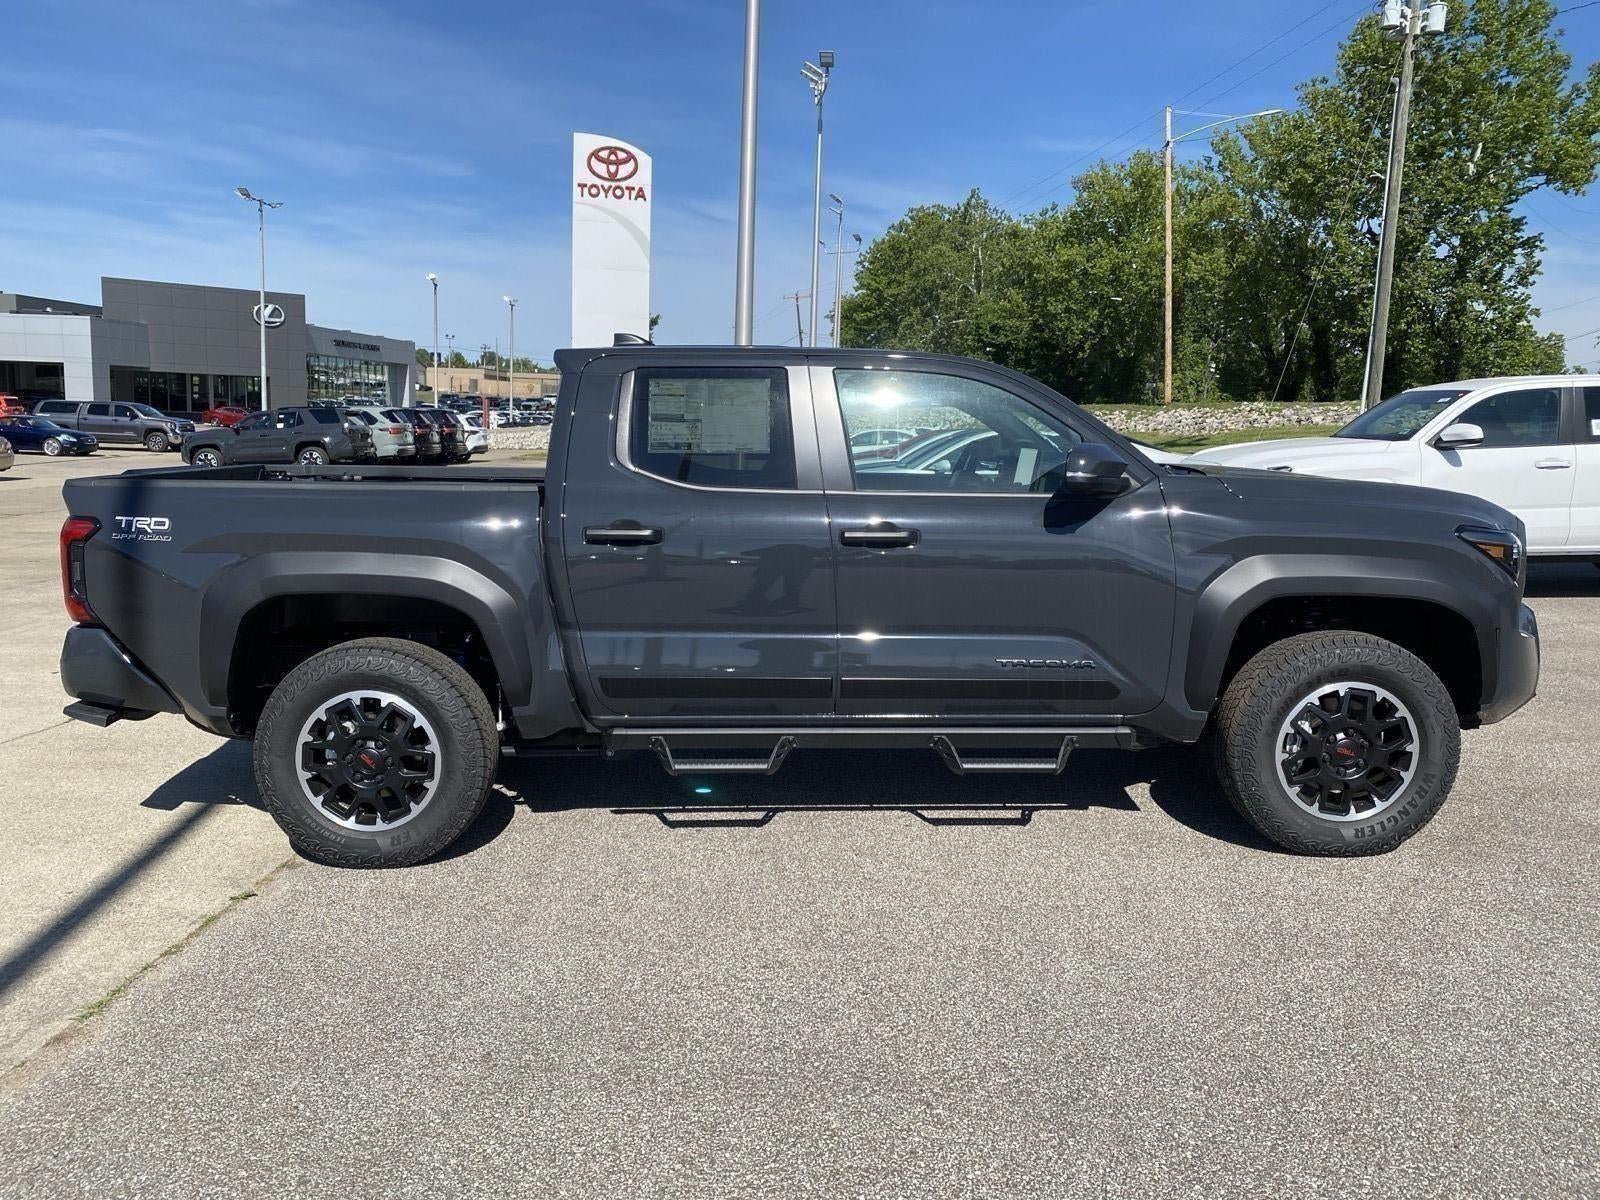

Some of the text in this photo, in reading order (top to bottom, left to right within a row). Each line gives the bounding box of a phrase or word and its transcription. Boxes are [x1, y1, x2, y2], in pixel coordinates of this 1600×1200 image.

[577, 182, 647, 201] TOYOTA
[114, 515, 171, 533] TRD
[995, 658, 1096, 670] TACOMA
[1353, 771, 1438, 839] WRANGLER
